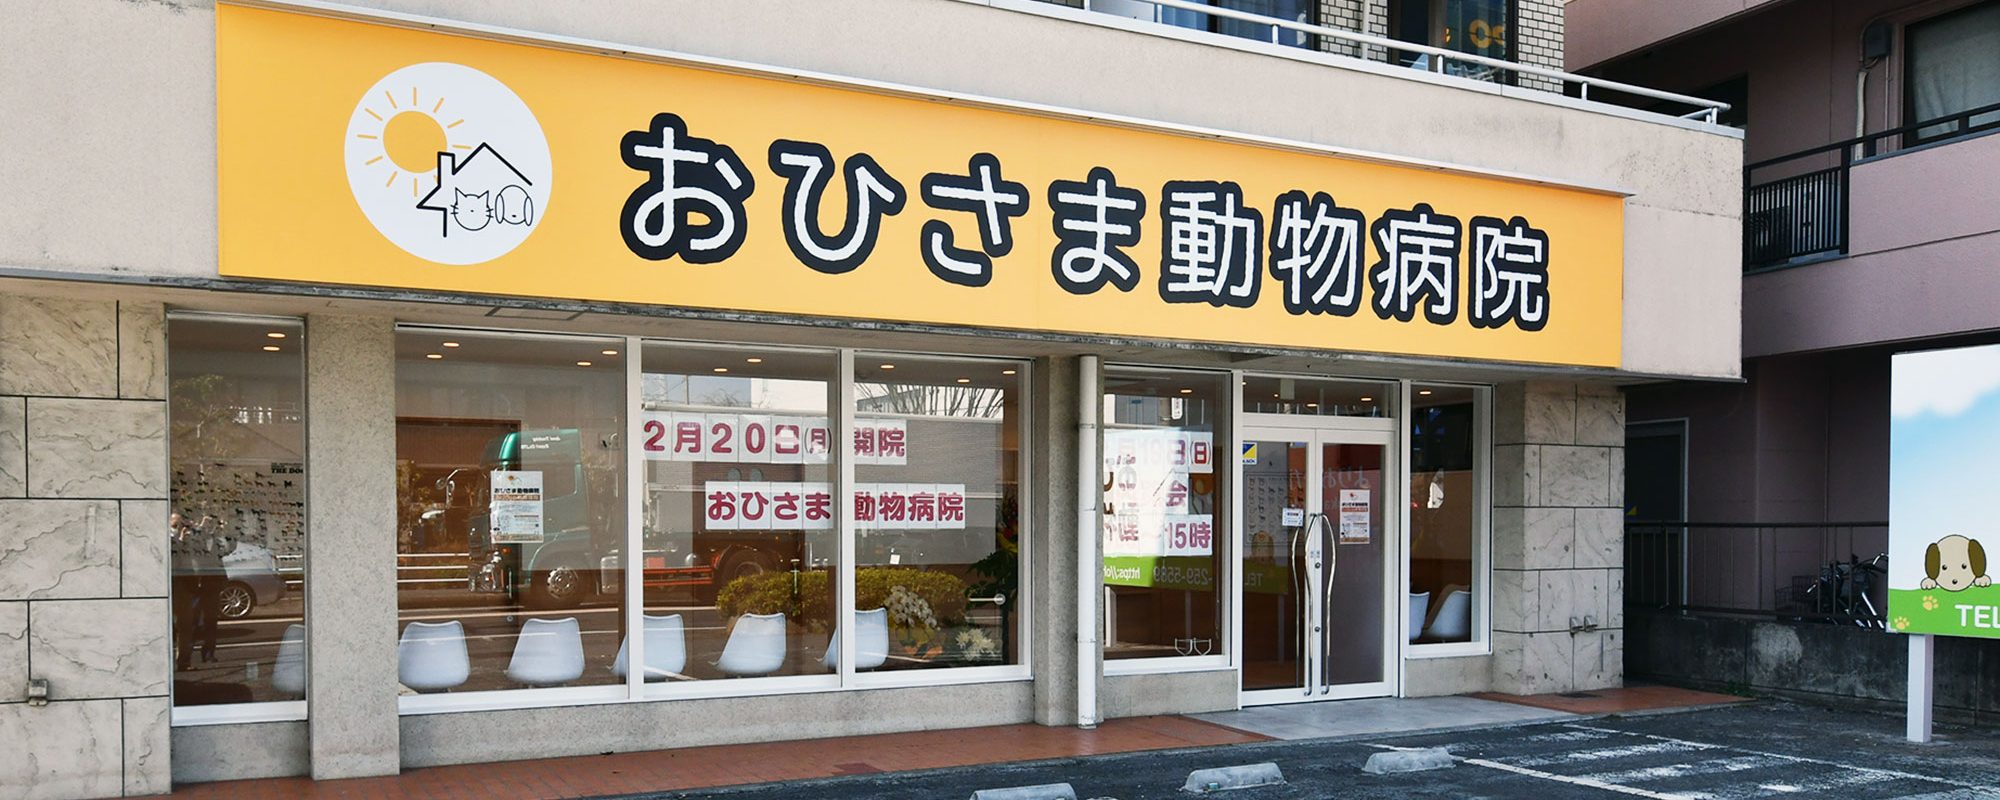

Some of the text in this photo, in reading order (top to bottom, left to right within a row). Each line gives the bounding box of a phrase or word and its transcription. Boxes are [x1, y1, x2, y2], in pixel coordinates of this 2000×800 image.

[620, 112, 1550, 329] おひさま動物病院
[643, 420, 905, 457] 2月20日(月) 開院
[707, 490, 964, 522] おひさま 動物病院
